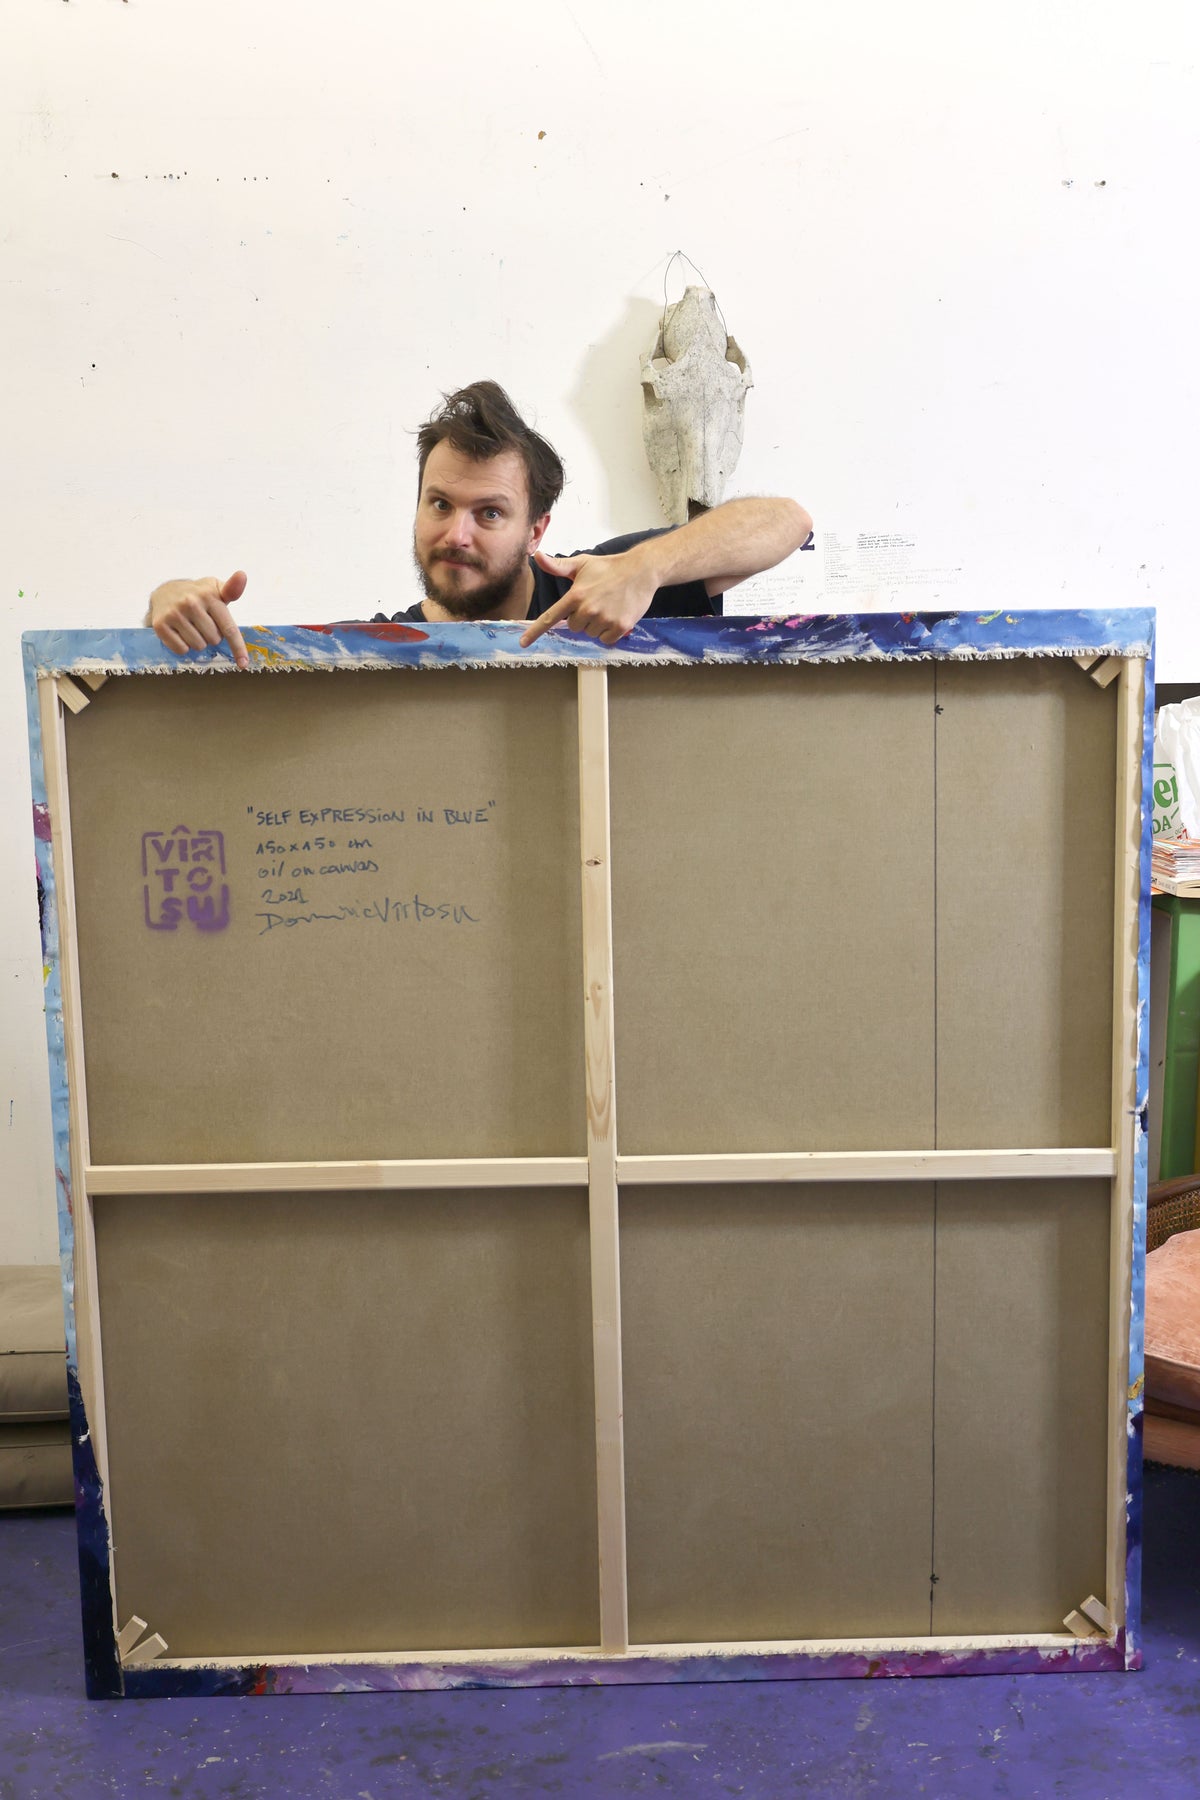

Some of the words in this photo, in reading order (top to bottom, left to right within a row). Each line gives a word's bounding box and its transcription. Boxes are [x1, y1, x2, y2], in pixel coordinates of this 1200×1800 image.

[258, 859, 285, 879] oil
[291, 866, 315, 878] on
[319, 859, 379, 875] canvas
[160, 895, 216, 923] SU
